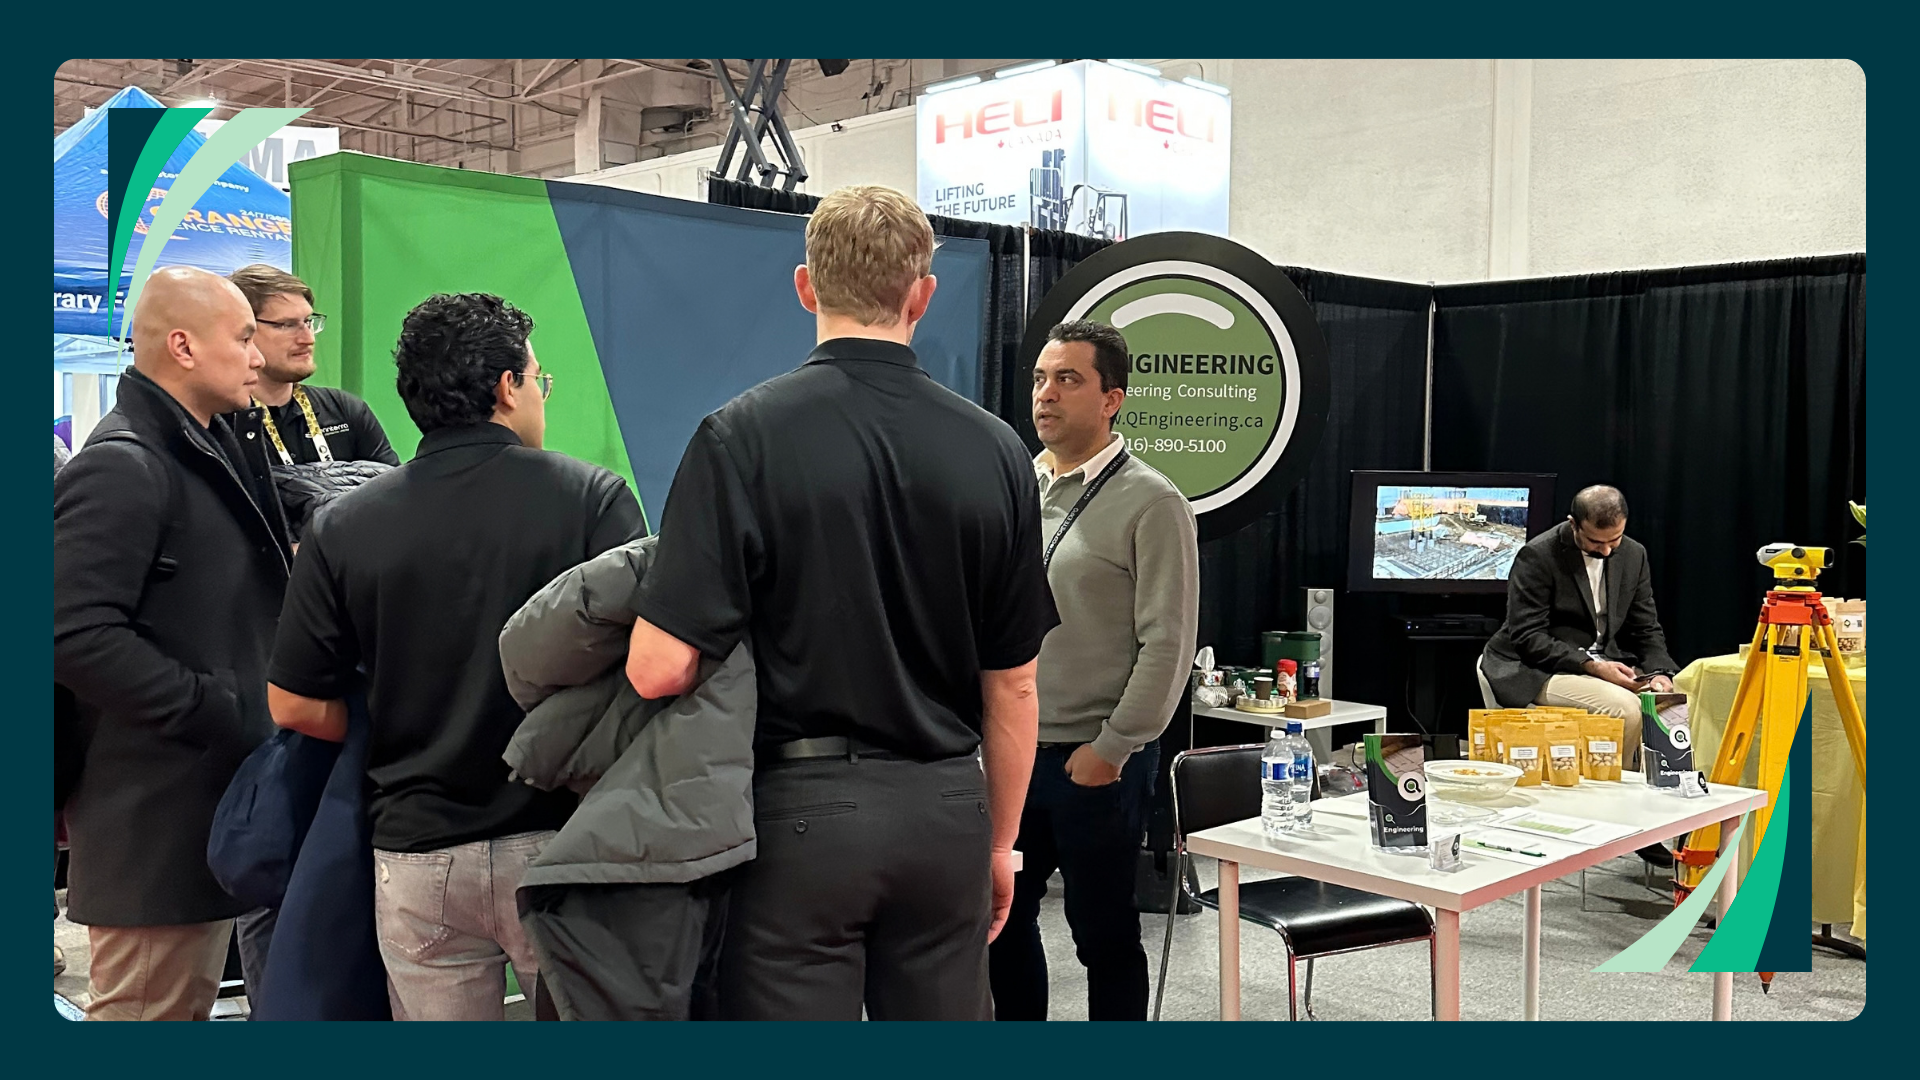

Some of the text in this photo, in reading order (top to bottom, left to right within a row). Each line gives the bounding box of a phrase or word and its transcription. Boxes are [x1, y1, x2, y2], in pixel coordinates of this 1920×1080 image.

[935, 88, 1063, 144] HELI
[936, 182, 984, 202] LIFTING
[935, 194, 1016, 216] THE FUTURE
[174, 223, 225, 234] ENCE
[1126, 383, 1257, 402] eering Consulting
[1126, 437, 1226, 454] 16)-890-5100
[1383, 826, 1424, 834] Engineering
